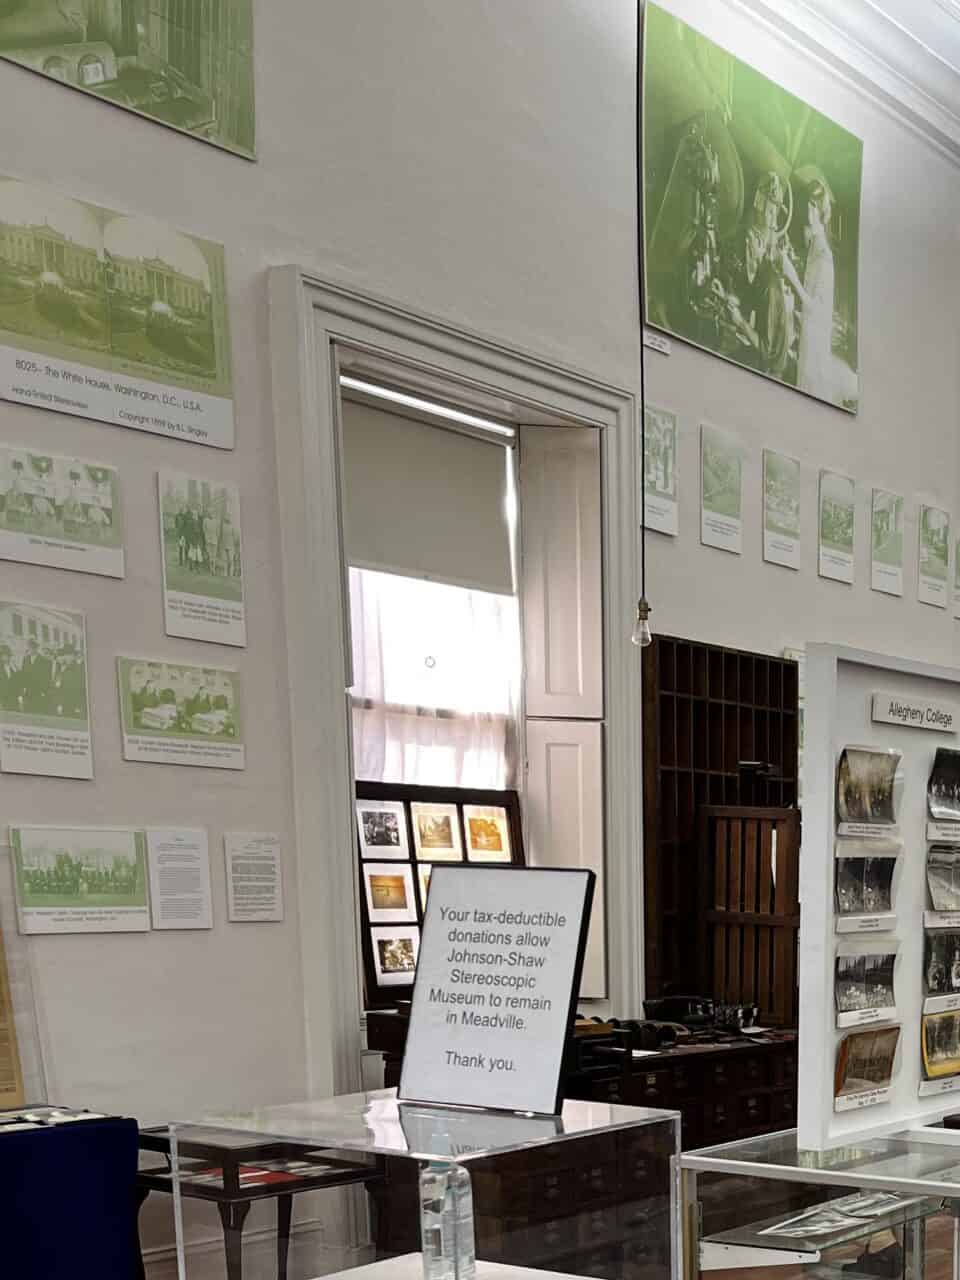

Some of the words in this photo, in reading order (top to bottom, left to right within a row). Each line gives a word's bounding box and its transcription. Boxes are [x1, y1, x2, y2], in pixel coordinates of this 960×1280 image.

[888, 701, 925, 725] Allegheny
[925, 707, 953, 728] College
[439, 906, 470, 923] Your
[473, 908, 567, 928] tax-deductible
[447, 928, 512, 946] donations
[516, 931, 551, 948] allow
[446, 949, 545, 968] Johnson-Shaw
[450, 969, 536, 991] Stereoscopic
[429, 989, 485, 1007] Museum
[489, 993, 501, 1008] to
[505, 995, 551, 1011] remain
[446, 1010, 457, 1025] in
[461, 1011, 527, 1030] Meadville.
[445, 1051, 485, 1069] Thank
[489, 1055, 517, 1072] you.
